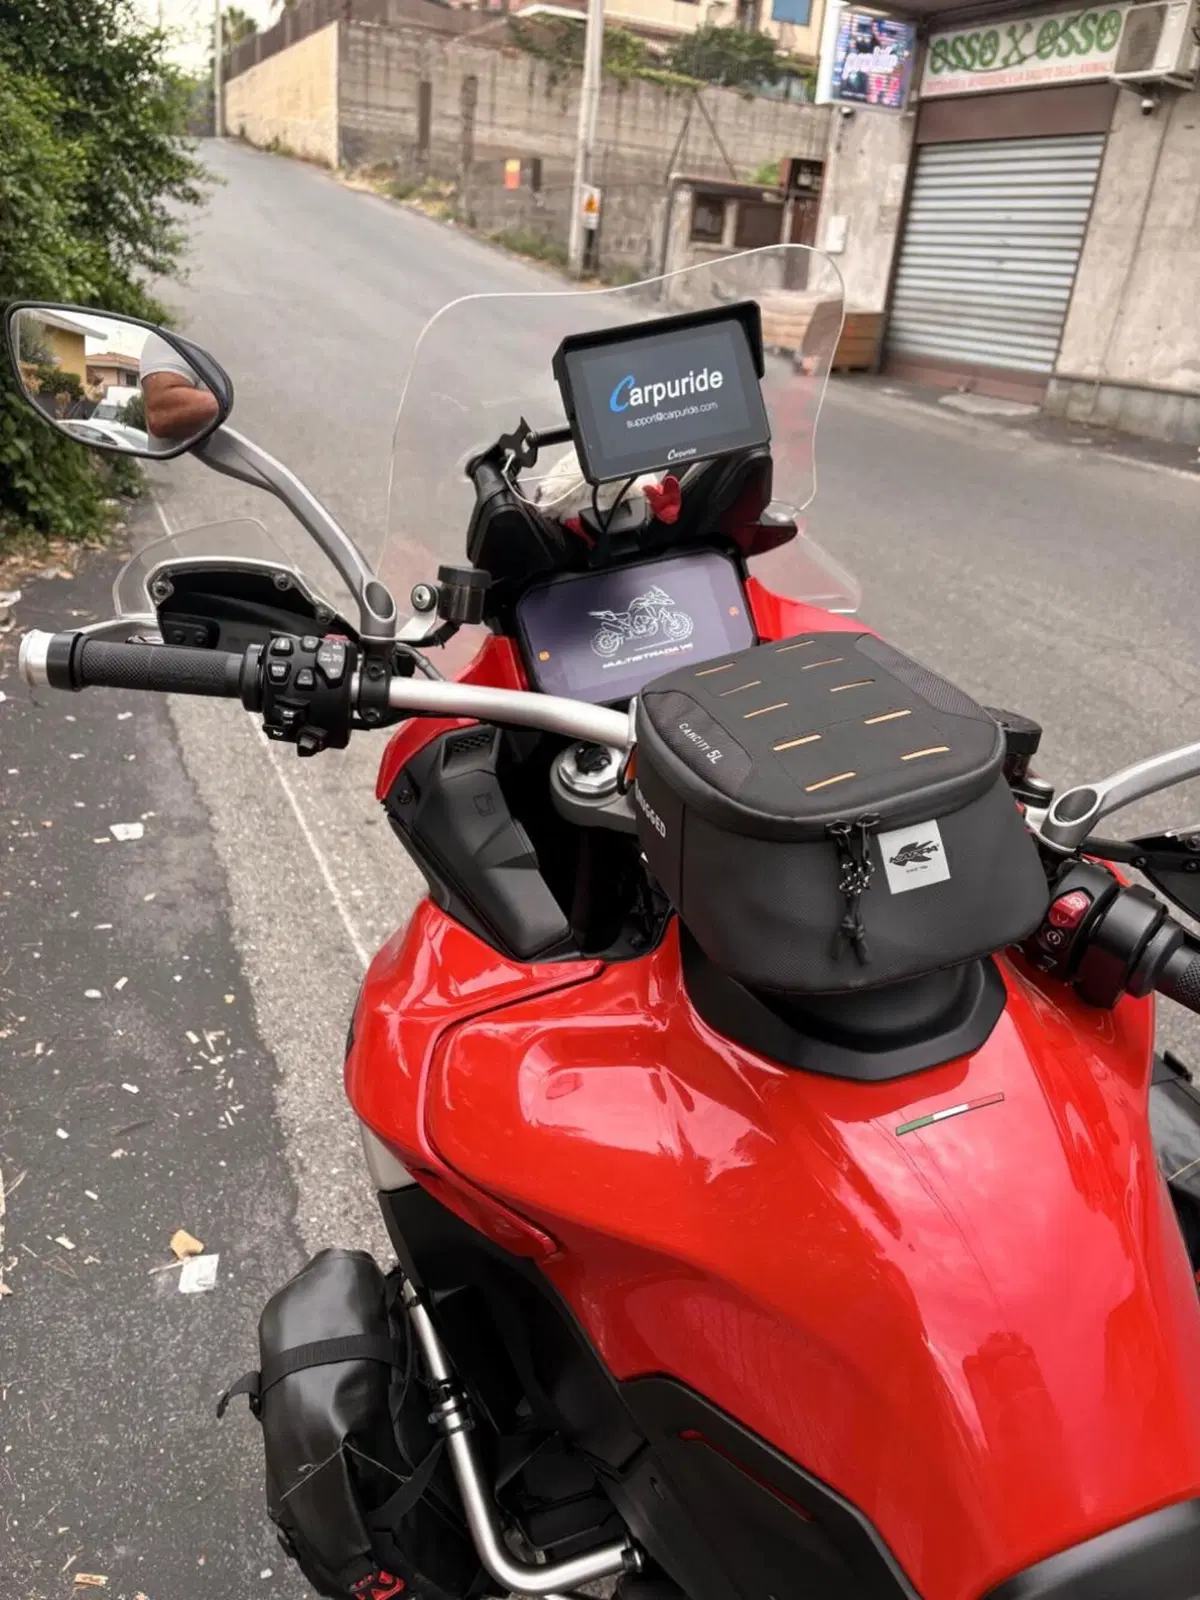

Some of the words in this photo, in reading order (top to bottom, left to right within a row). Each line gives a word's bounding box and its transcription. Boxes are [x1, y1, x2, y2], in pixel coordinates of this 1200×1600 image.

[610, 367, 723, 412] Carpuride
[626, 402, 719, 428] support@carpuride.com
[706, 749, 723, 764] 5L
